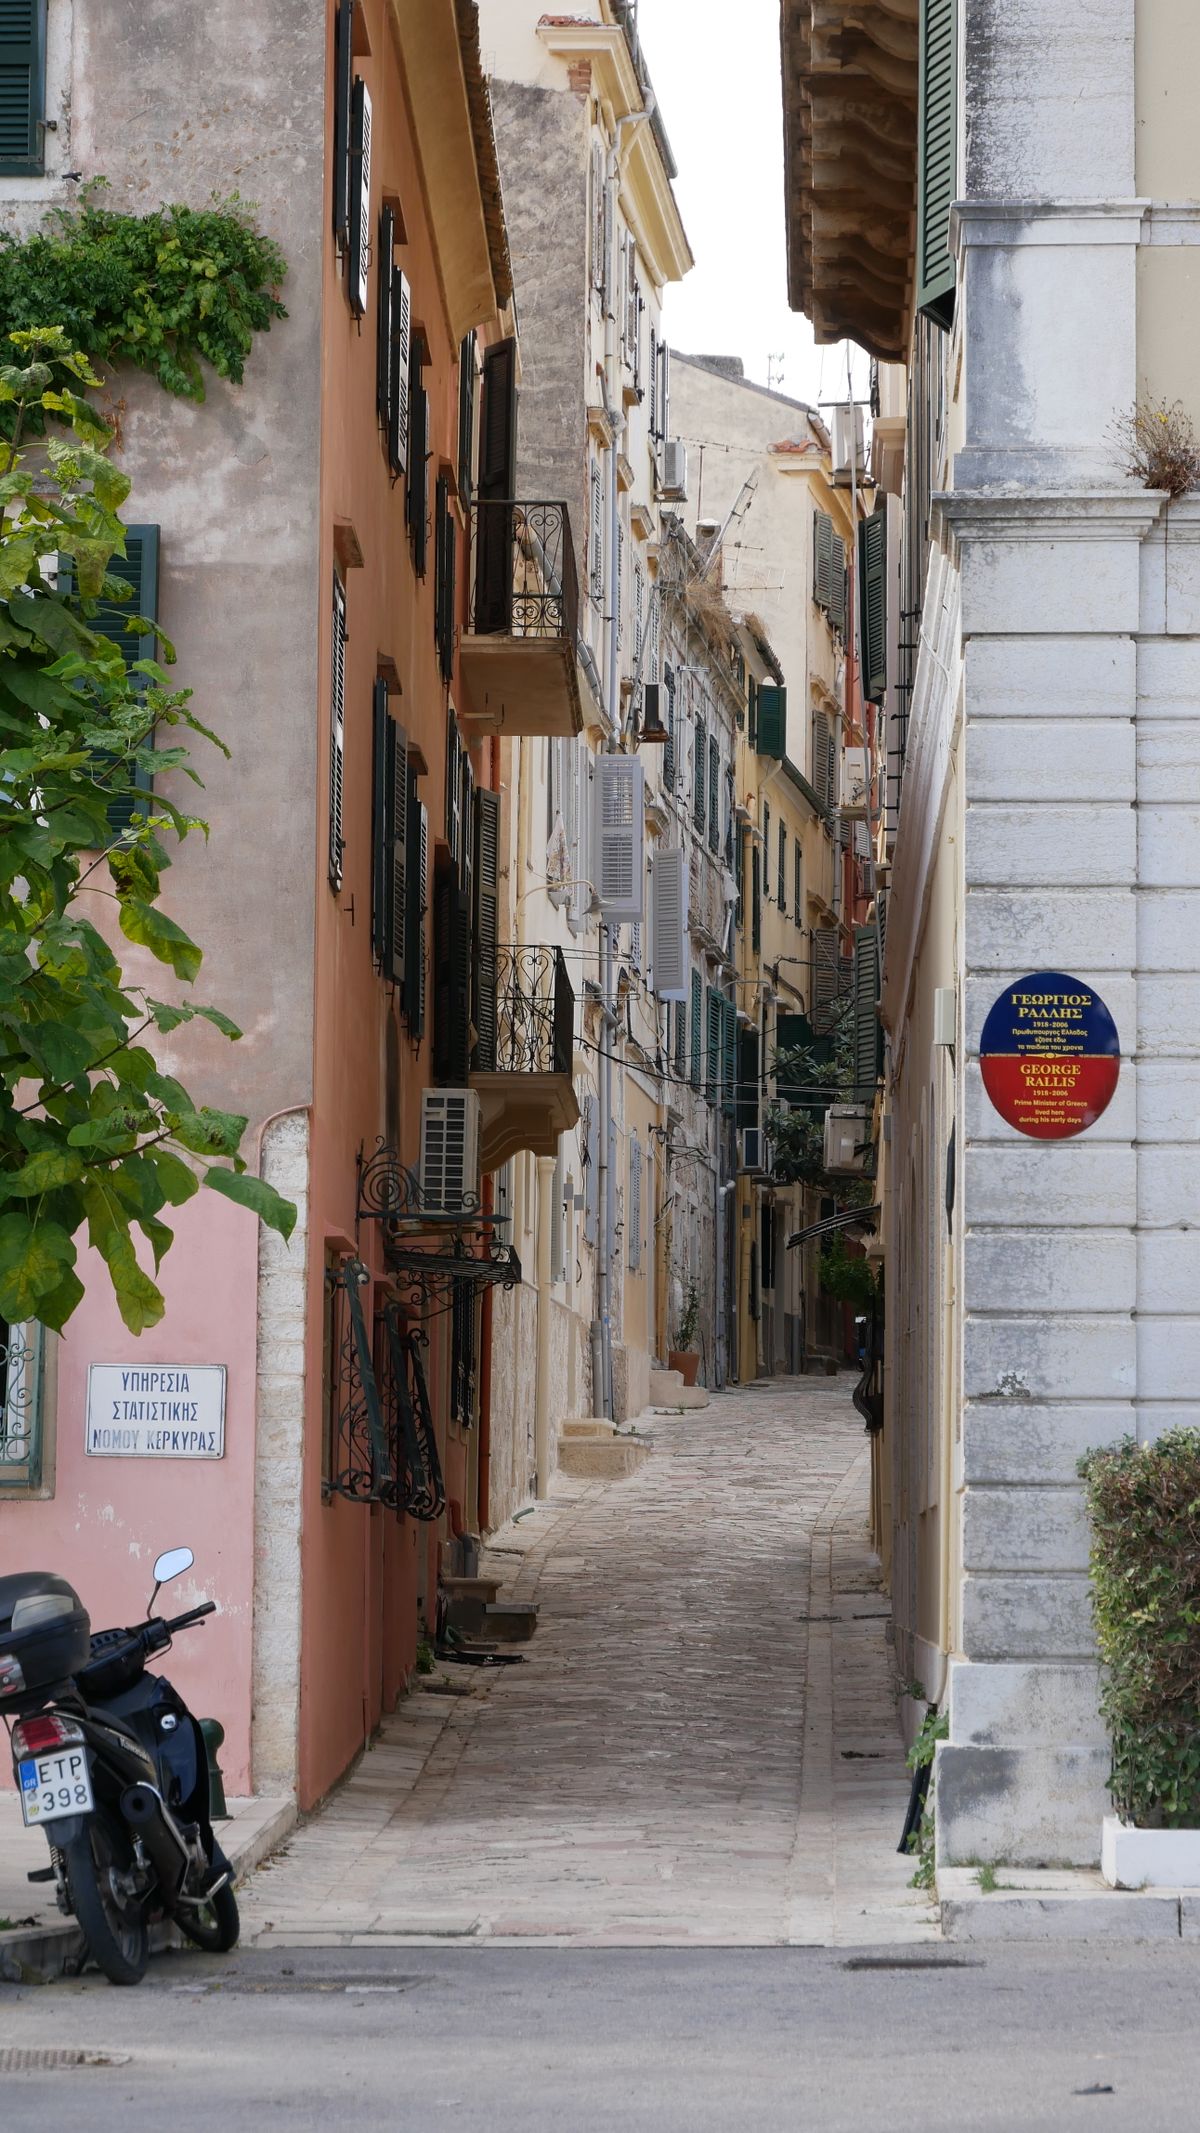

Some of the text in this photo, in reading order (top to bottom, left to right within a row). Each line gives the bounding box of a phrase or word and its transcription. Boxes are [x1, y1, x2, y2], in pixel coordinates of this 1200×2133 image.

[1011, 994, 1092, 1006] ΓΕΩΡΓΙΟΣ
[1018, 1008, 1082, 1018] ΡΑΛΛΗΣ
[1020, 1064, 1081, 1074] GEORGE
[1025, 1077, 1076, 1088] RALLIS
[122, 1372, 190, 1392] ΥΠΗΡΕΣΙΑ
[112, 1401, 198, 1422] ΣΤΑΤΙΣΤΙΚΗΣ
[93, 1429, 216, 1451] ΝΟΜΟΥ ΚΕΡΚΥΡΑΣ
[24, 1778, 37, 1788] GR
[42, 1784, 88, 1812] 398
